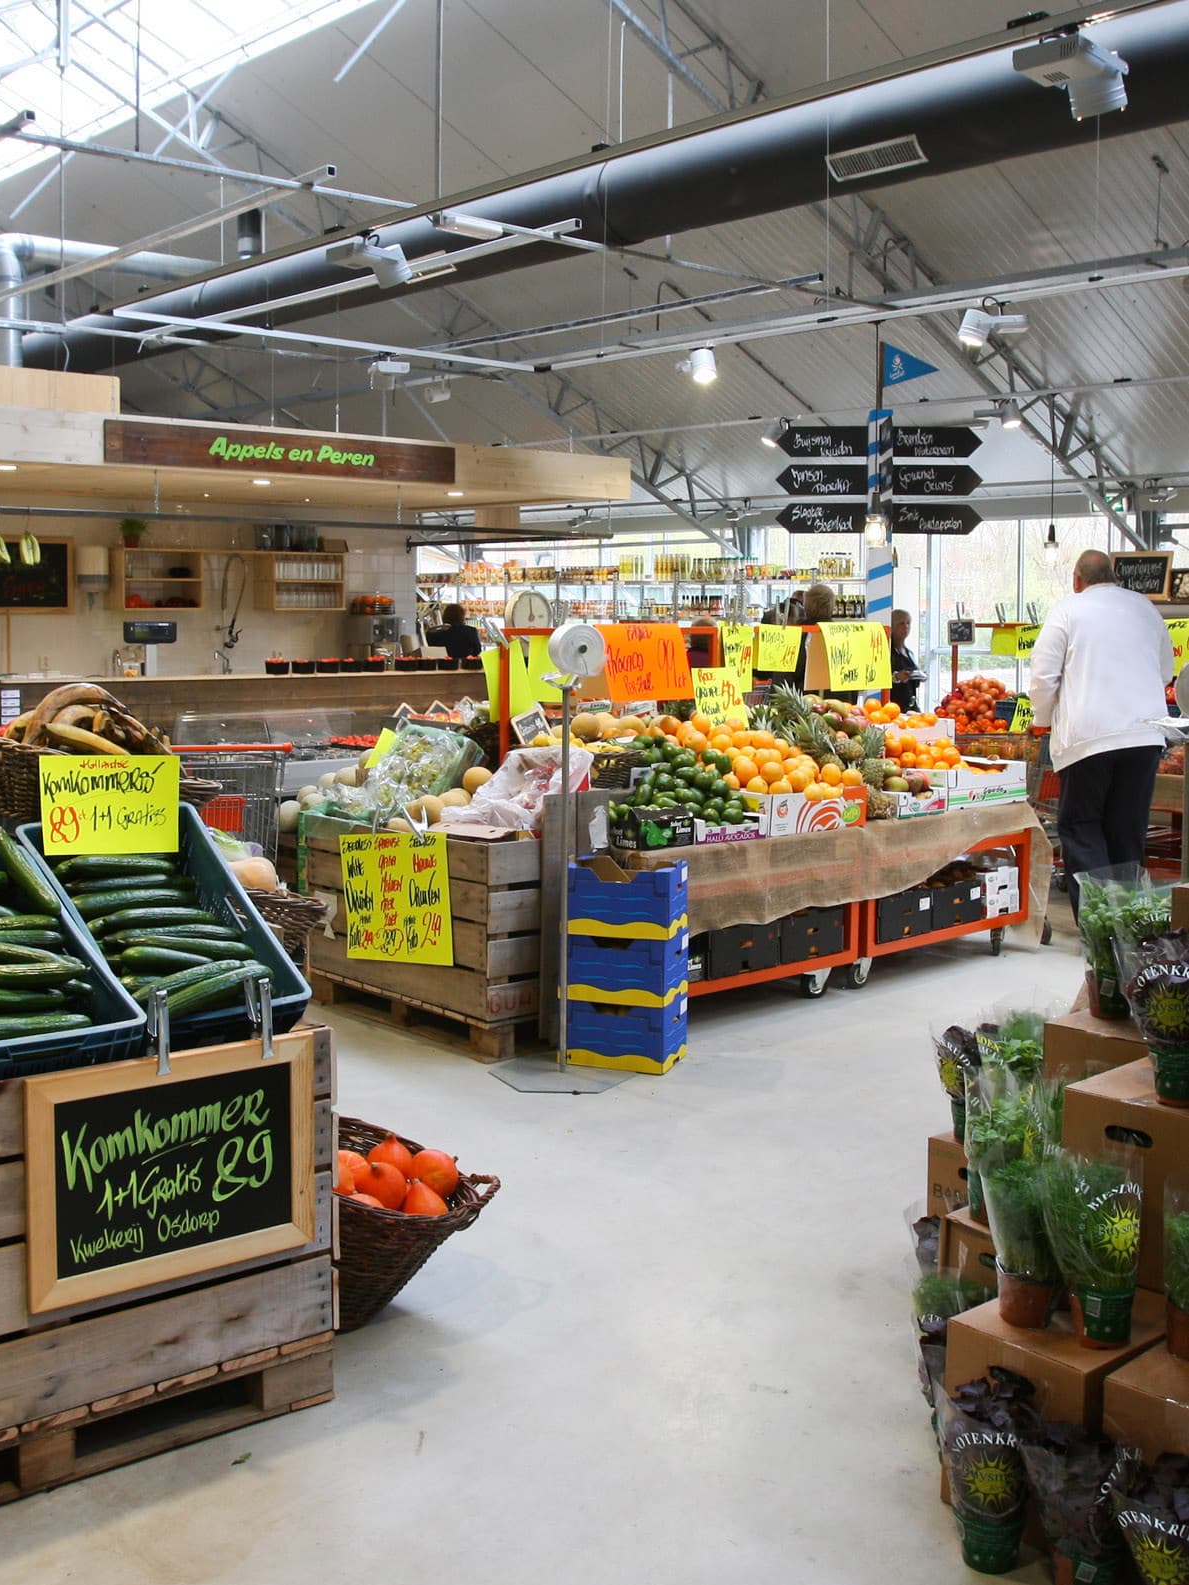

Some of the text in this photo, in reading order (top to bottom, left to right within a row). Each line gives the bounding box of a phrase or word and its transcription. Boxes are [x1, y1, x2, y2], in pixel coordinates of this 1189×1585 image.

[209, 437, 376, 466] Appels en Peren
[50, 806, 80, 844] 89
[616, 836, 636, 848] Limes
[96, 1168, 137, 1220] 1+1
[212, 1129, 274, 1202] 89
